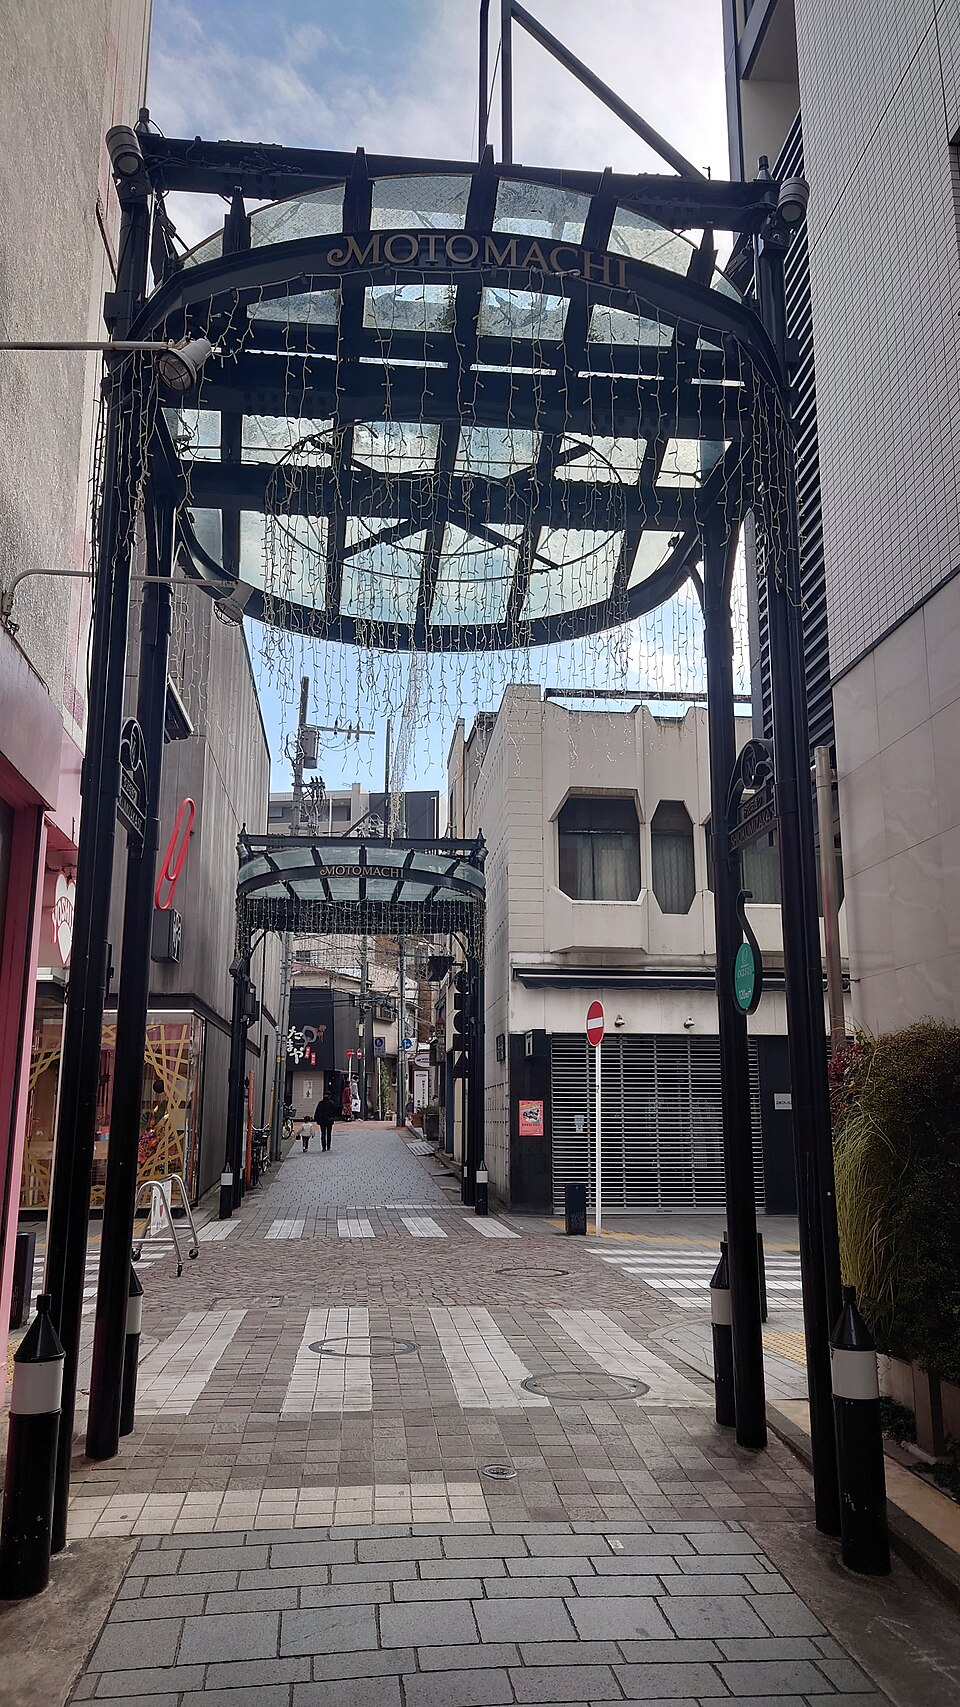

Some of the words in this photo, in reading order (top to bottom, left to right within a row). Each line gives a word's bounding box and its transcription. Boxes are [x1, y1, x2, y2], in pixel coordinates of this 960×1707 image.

[326, 233, 630, 288] MOTOMACHI
[319, 865, 404, 878] MOTOMACHI
[286, 1025, 304, 1065] たまや
